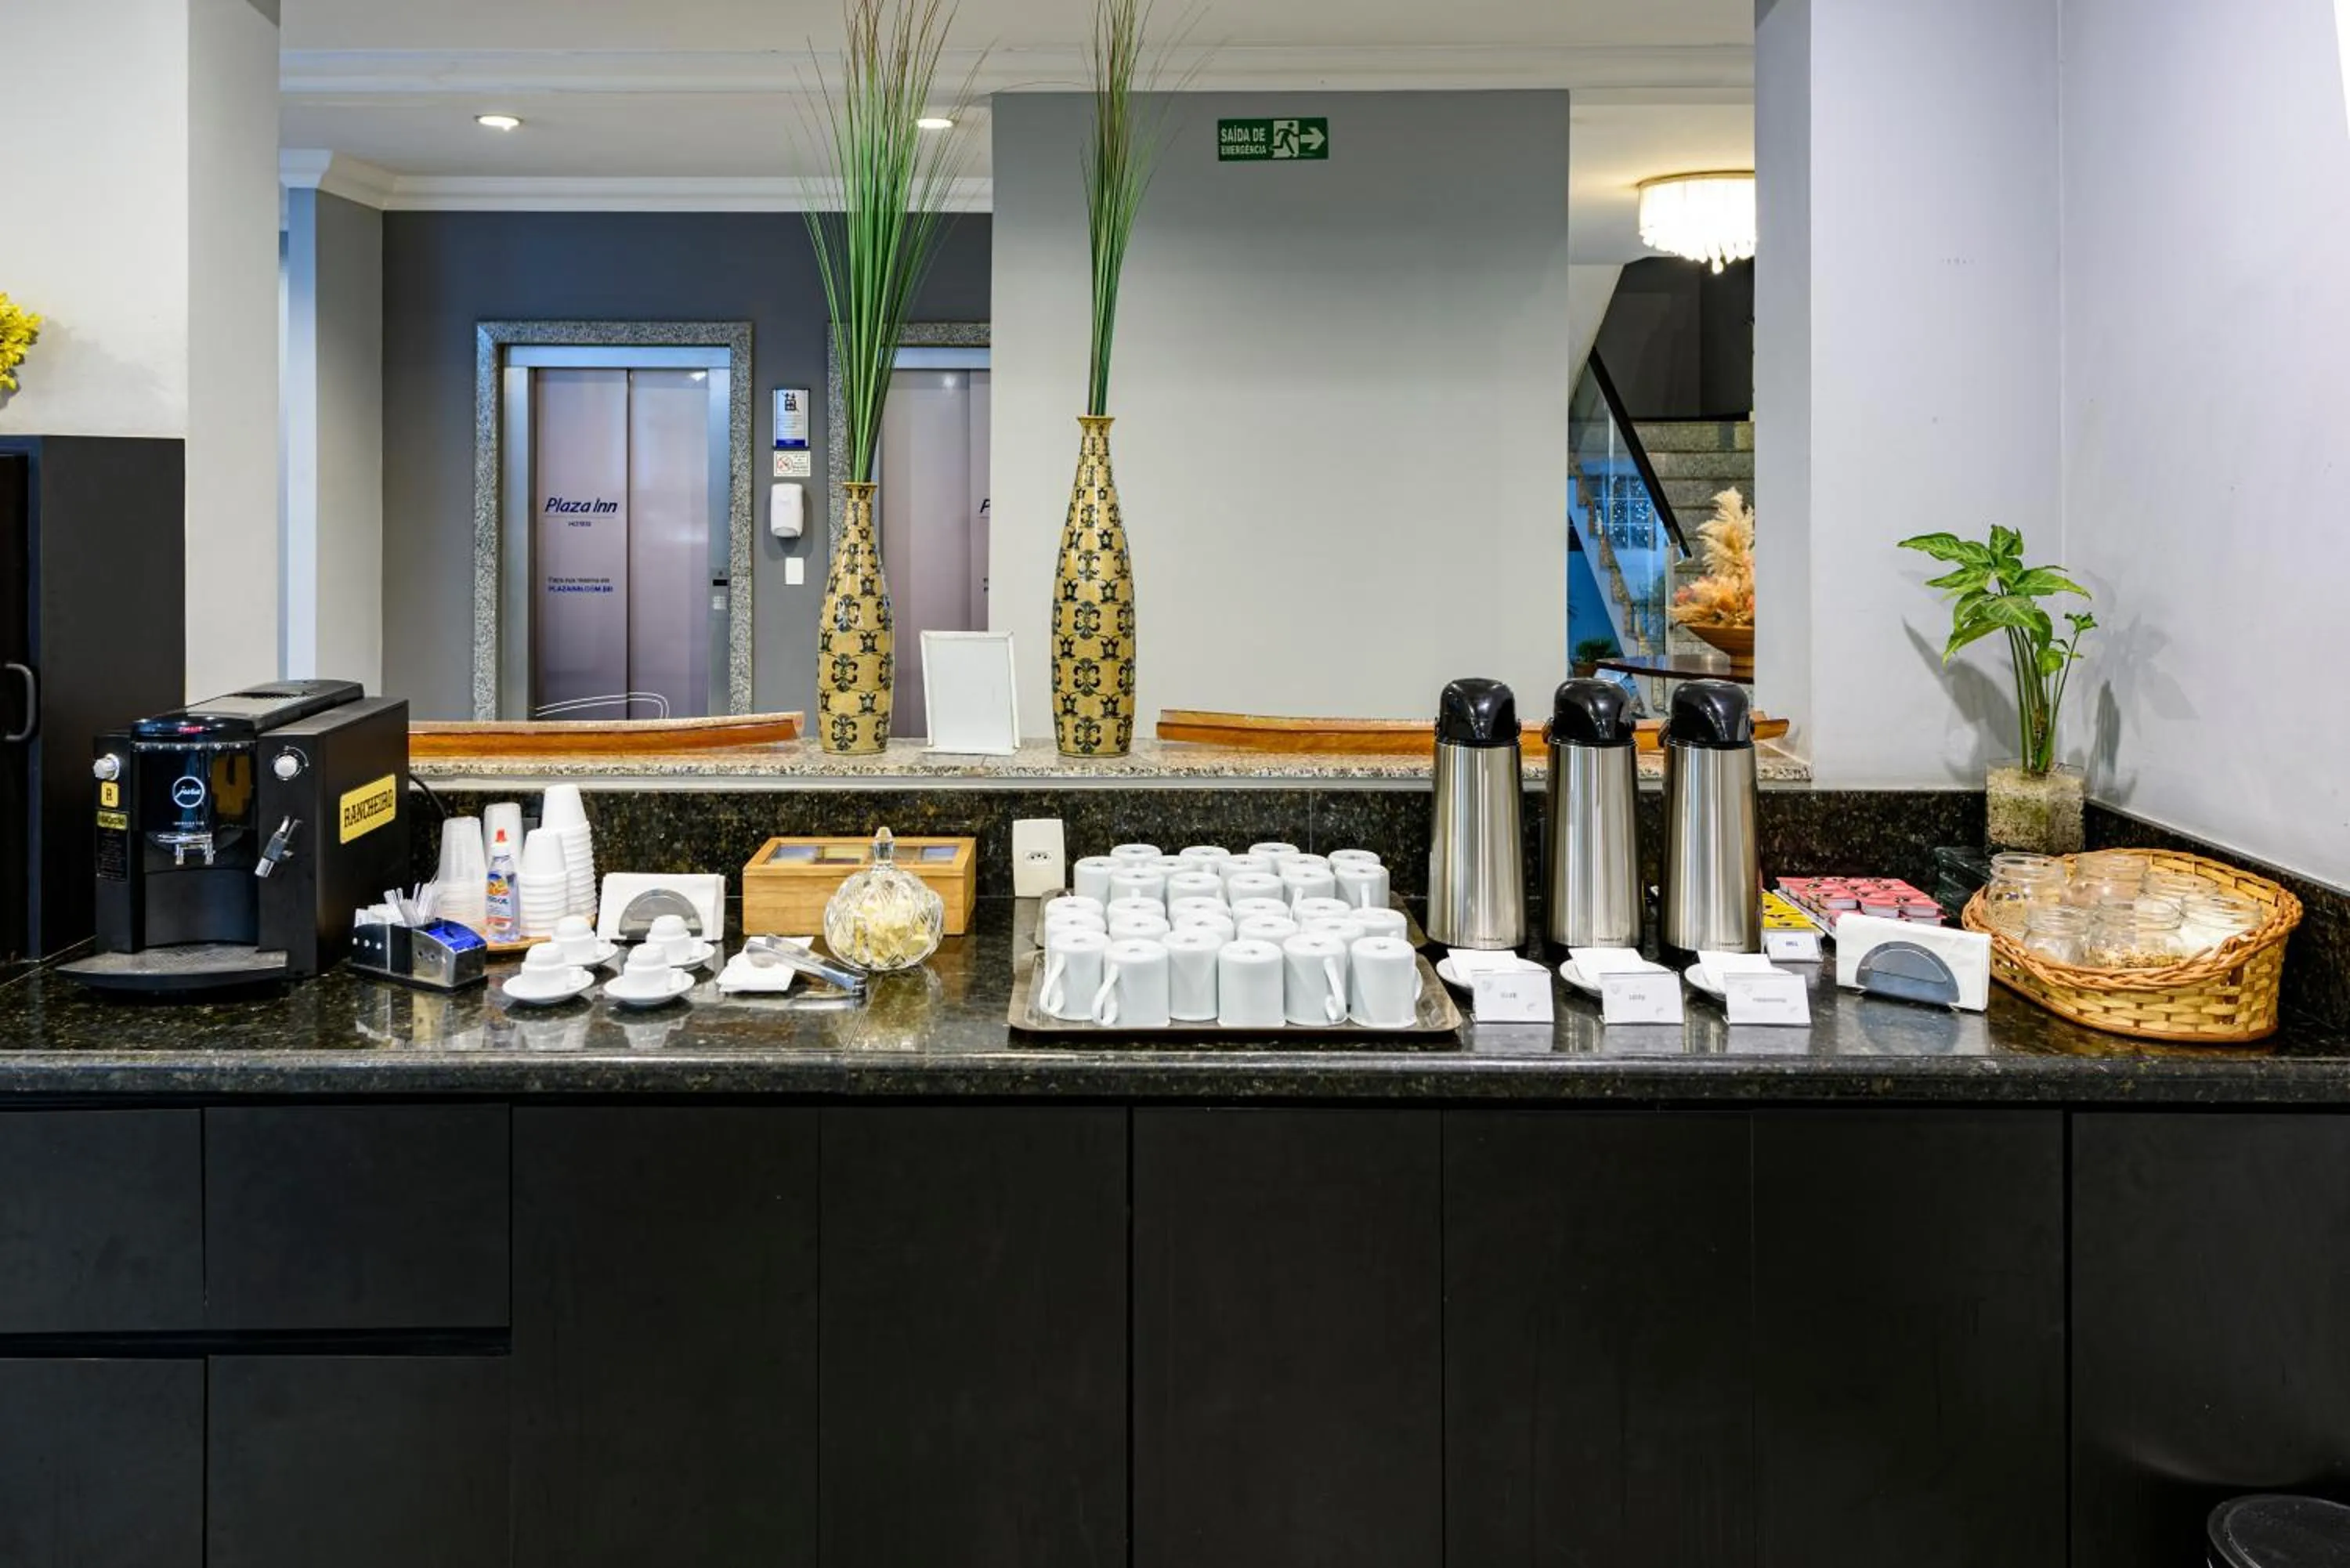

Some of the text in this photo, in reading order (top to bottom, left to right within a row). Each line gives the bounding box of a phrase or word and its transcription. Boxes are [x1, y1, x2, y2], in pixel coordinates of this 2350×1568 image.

[1220, 125, 1266, 142] SAÍDA DE
[544, 497, 591, 513] Plaza
